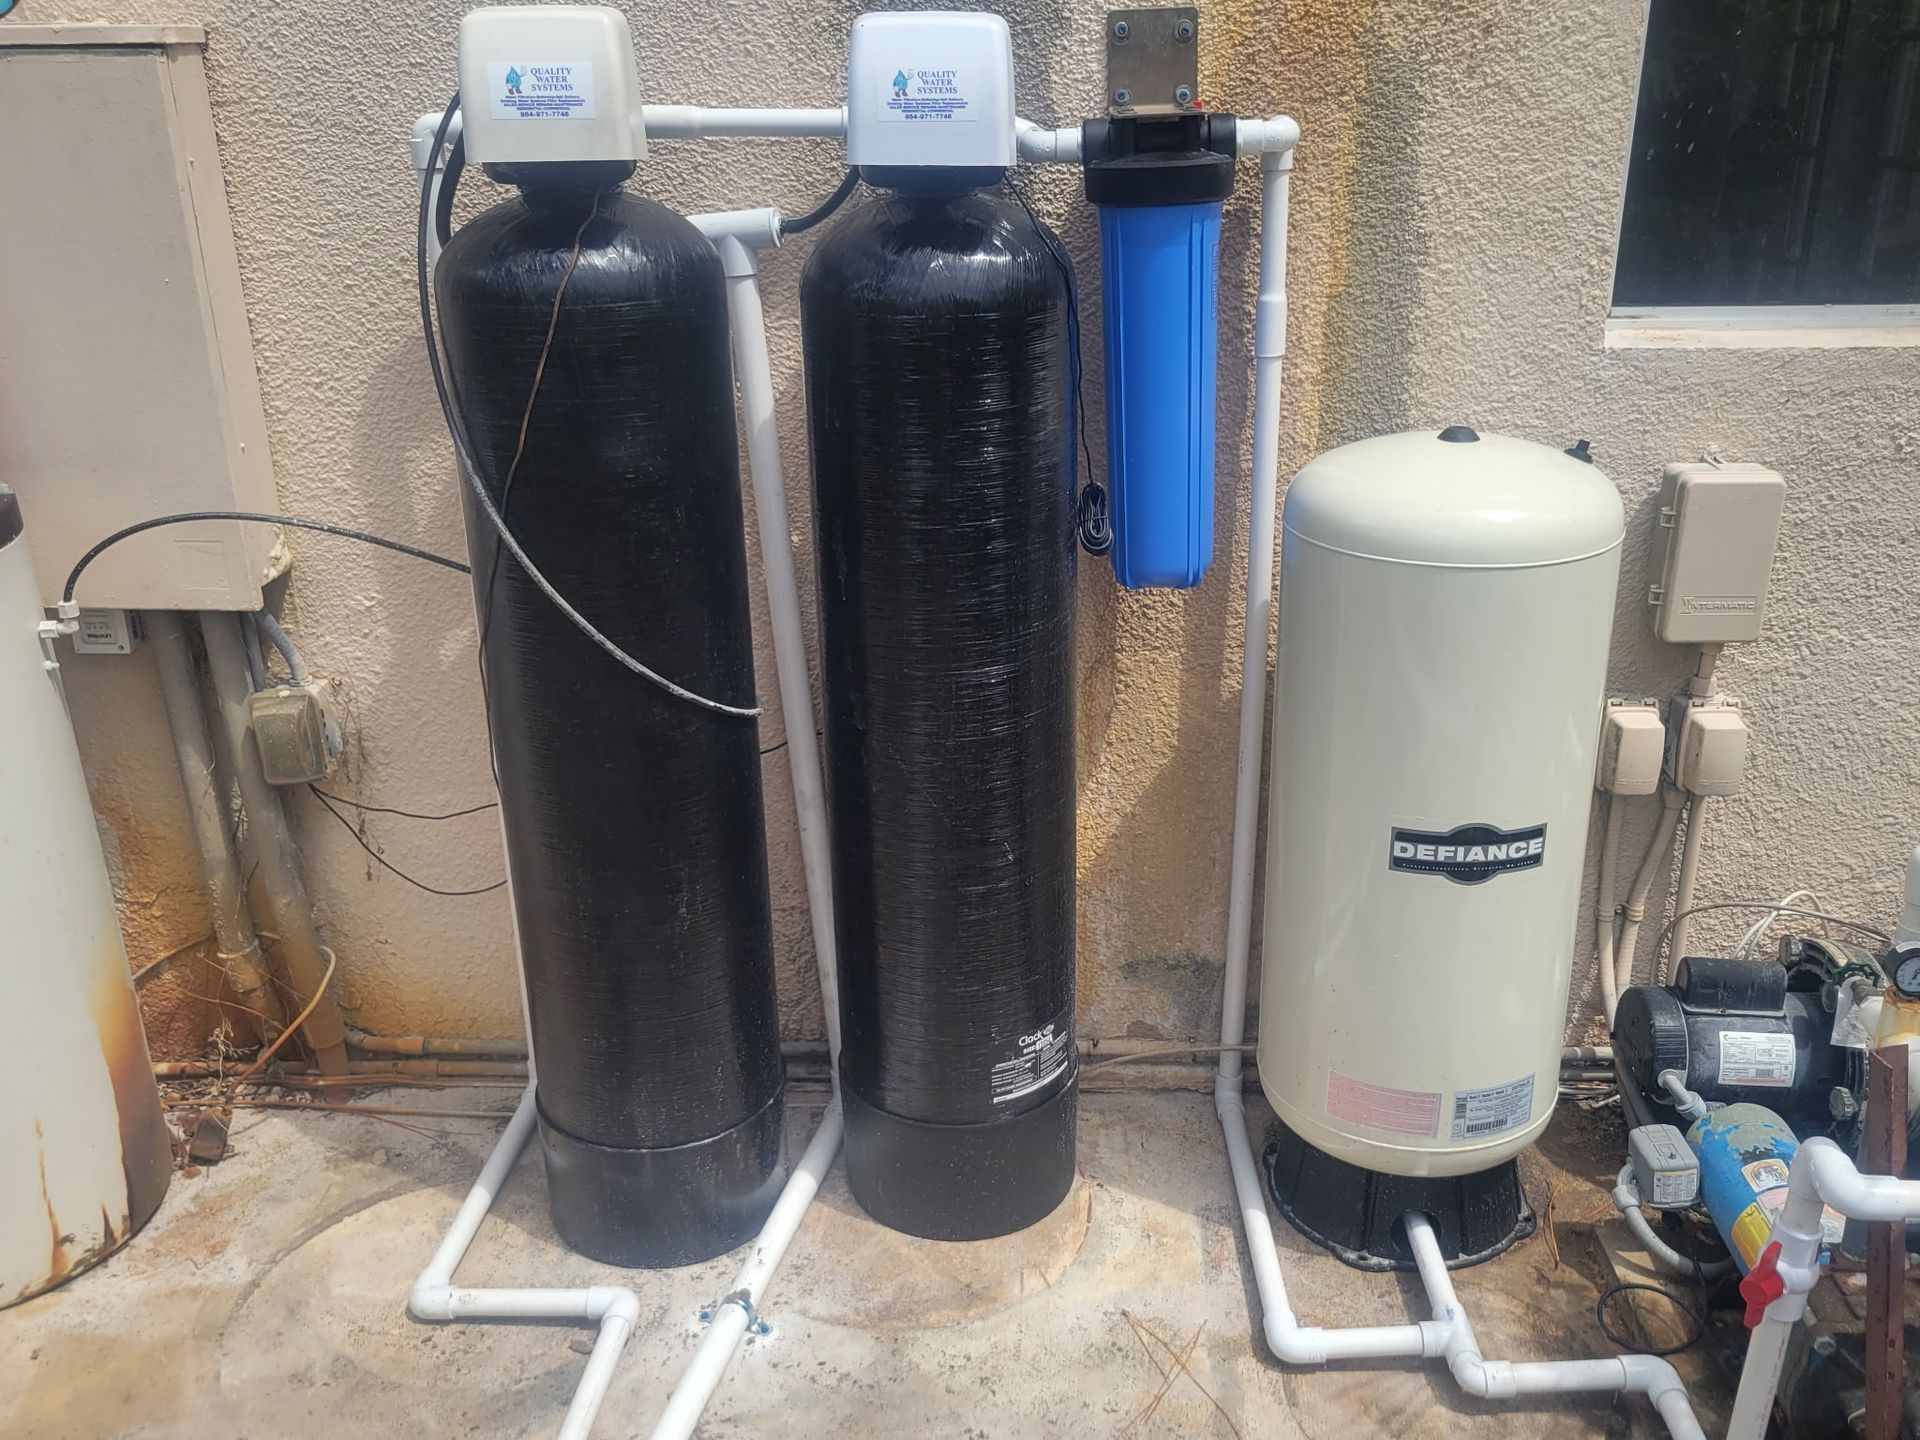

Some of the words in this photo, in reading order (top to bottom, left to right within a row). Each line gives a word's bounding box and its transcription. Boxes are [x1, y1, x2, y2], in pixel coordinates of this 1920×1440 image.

[530, 67, 572, 77] QUALITY
[917, 70, 958, 80] QUALITY
[536, 75, 568, 83] WATER
[922, 78, 953, 86] WATER
[531, 83, 574, 92] SYSTEMS
[917, 86, 958, 95] SYSTEMS
[1680, 596, 1755, 615] INTERMATIC
[1393, 837, 1544, 862] DEFIANCE
